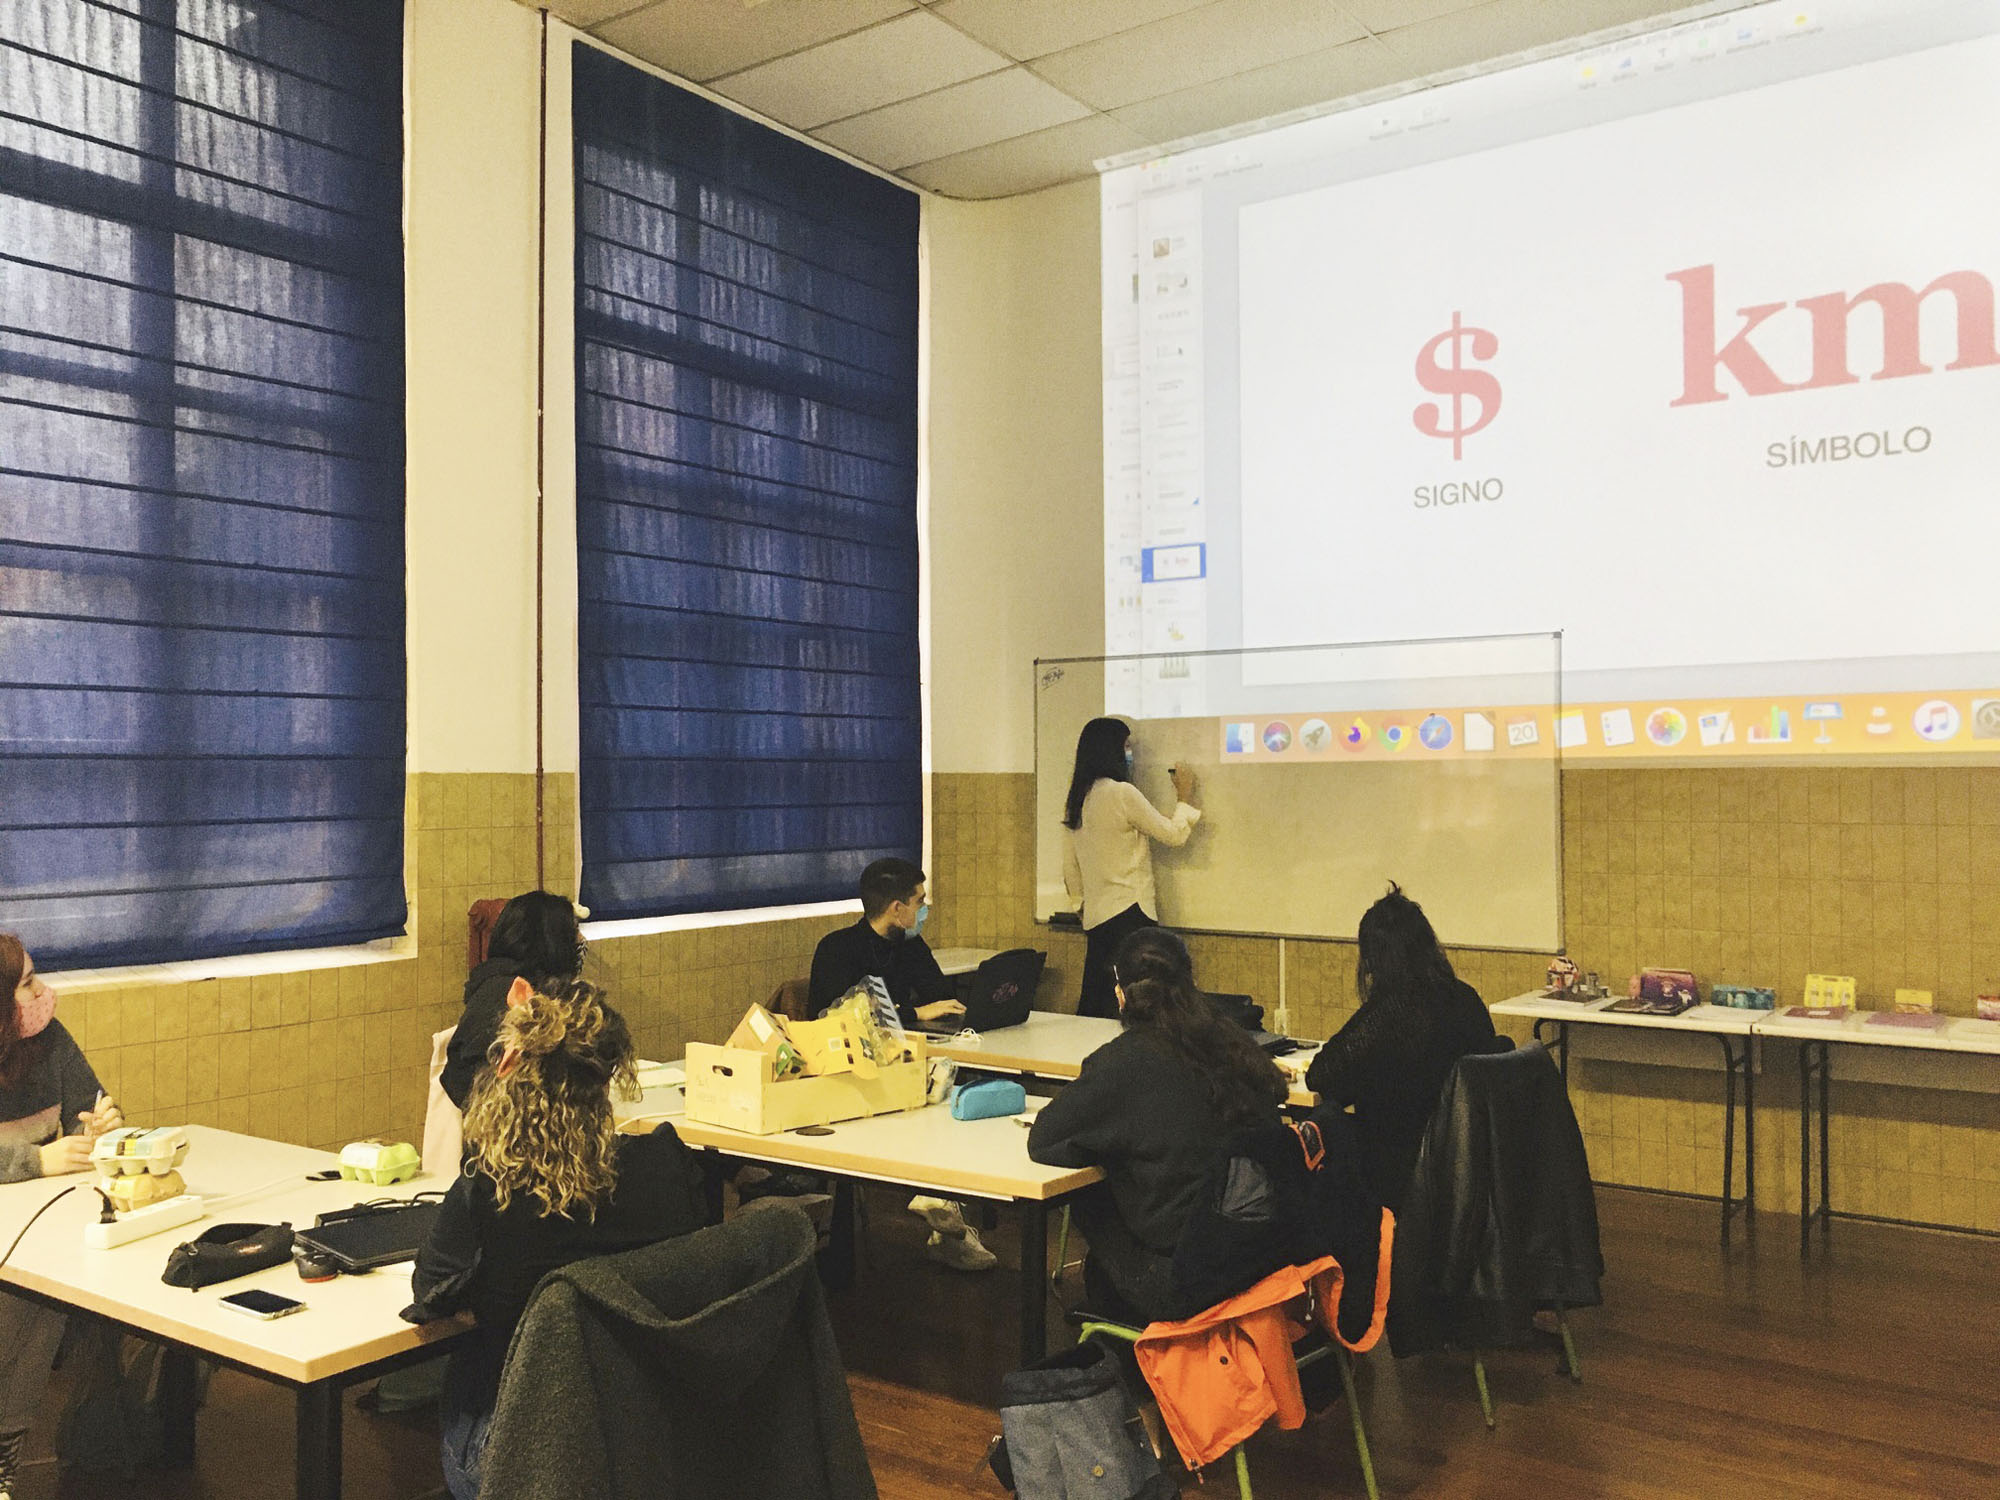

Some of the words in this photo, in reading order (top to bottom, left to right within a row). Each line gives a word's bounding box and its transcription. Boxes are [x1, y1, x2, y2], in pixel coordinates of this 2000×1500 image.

[1666, 264, 2000, 408] km
[1766, 425, 1932, 469] SÍMBOLO
[1413, 477, 1504, 510] SIGNO
[1511, 724, 1533, 741] 20
